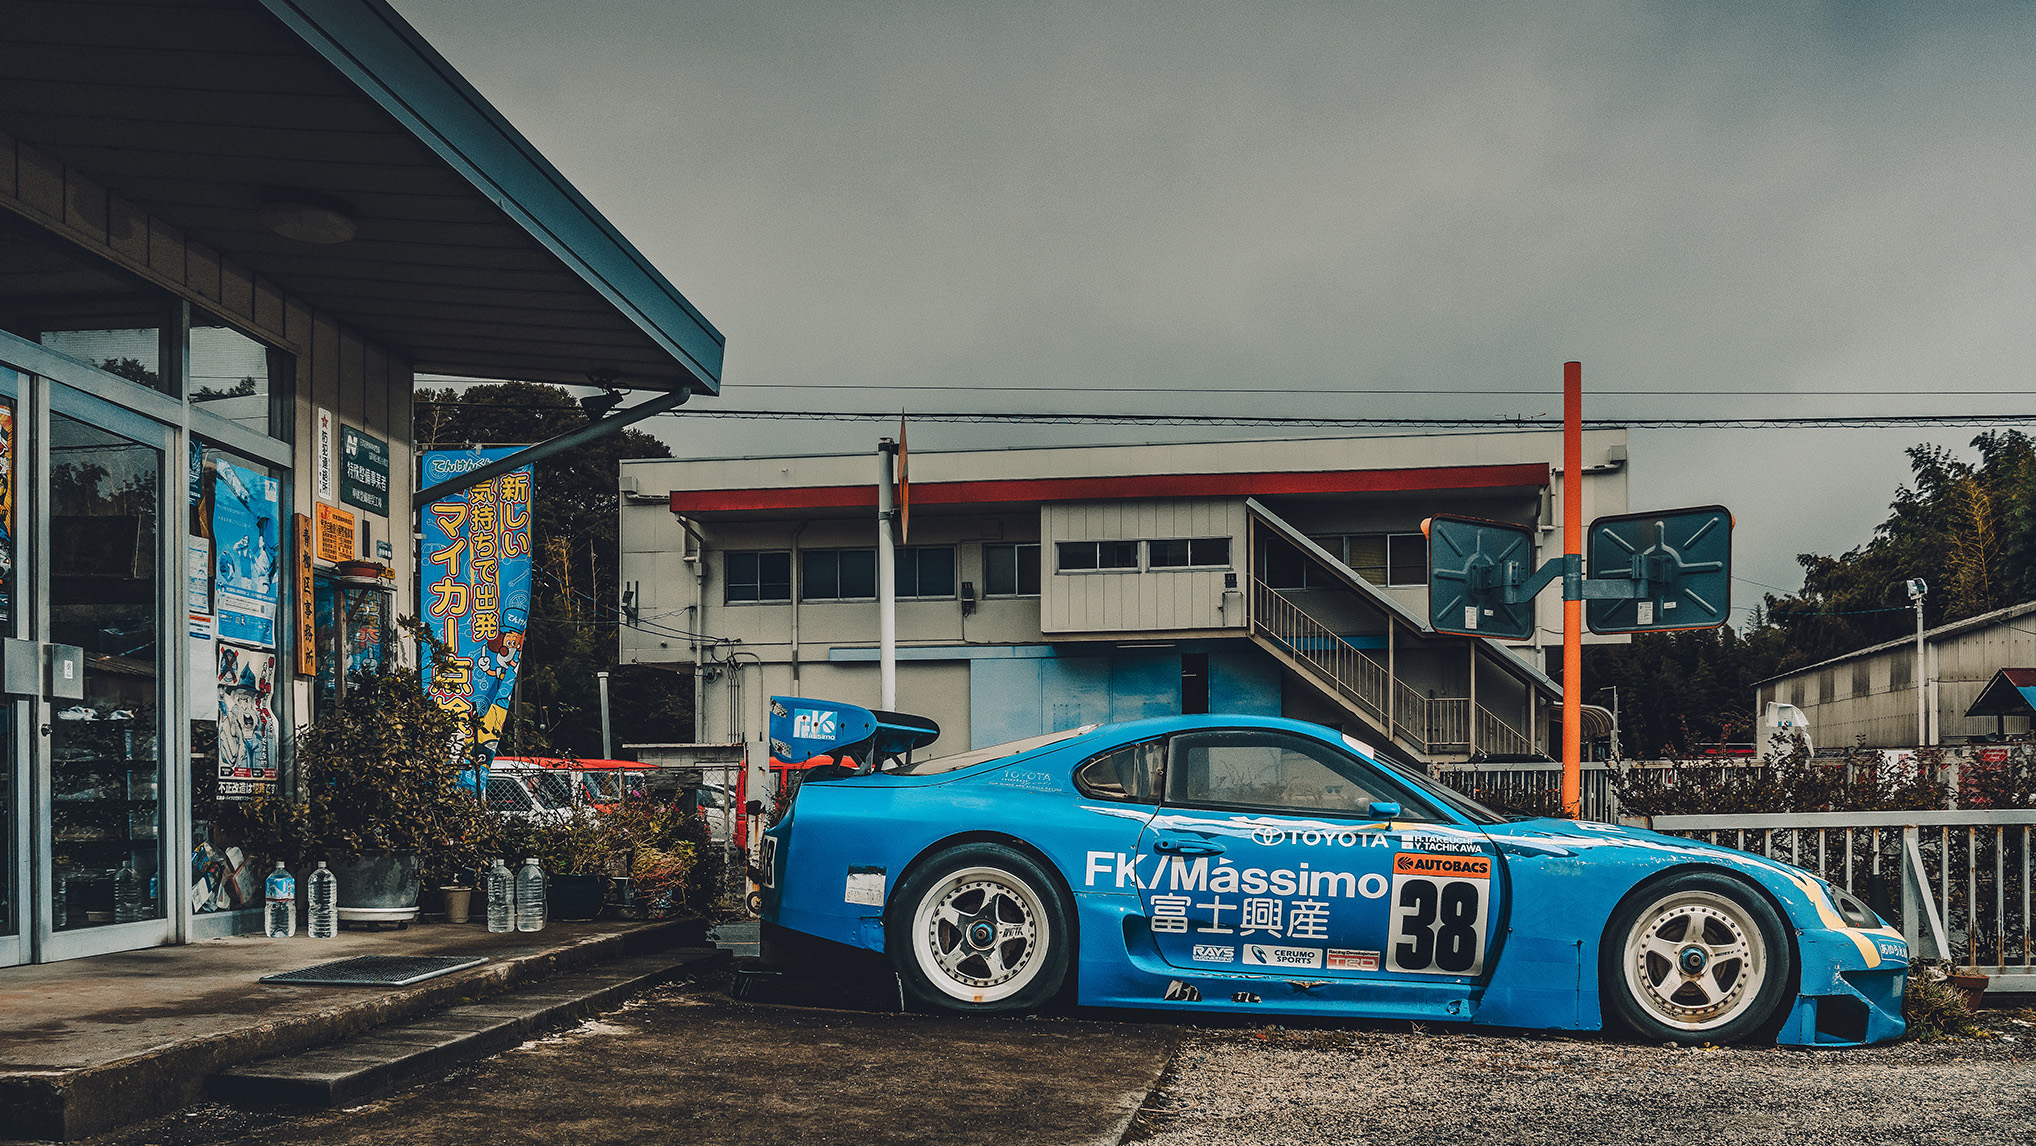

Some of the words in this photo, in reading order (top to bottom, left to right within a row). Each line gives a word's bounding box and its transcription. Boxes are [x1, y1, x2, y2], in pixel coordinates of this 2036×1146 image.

[346, 460, 387, 492] 特殊整備事業者
[501, 475, 529, 556] 新しい
[471, 479, 498, 640] 気持ちで出発
[302, 529, 314, 666] 青柳区事務所
[1004, 770, 1051, 782] TOYOTA
[1290, 832, 1389, 849] TOYOTA
[1414, 835, 1472, 844] H.TAKEUCHI
[1414, 842, 1482, 853] Y.TACHIKAWA
[1414, 859, 1488, 874] AUTOBACS
[1151, 893, 1329, 940] 富士興産
[1396, 879, 1479, 972] 38
[1193, 946, 1234, 957] RAYS
[1274, 949, 1314, 958] CERUMO
[1330, 956, 1377, 968] TRD
